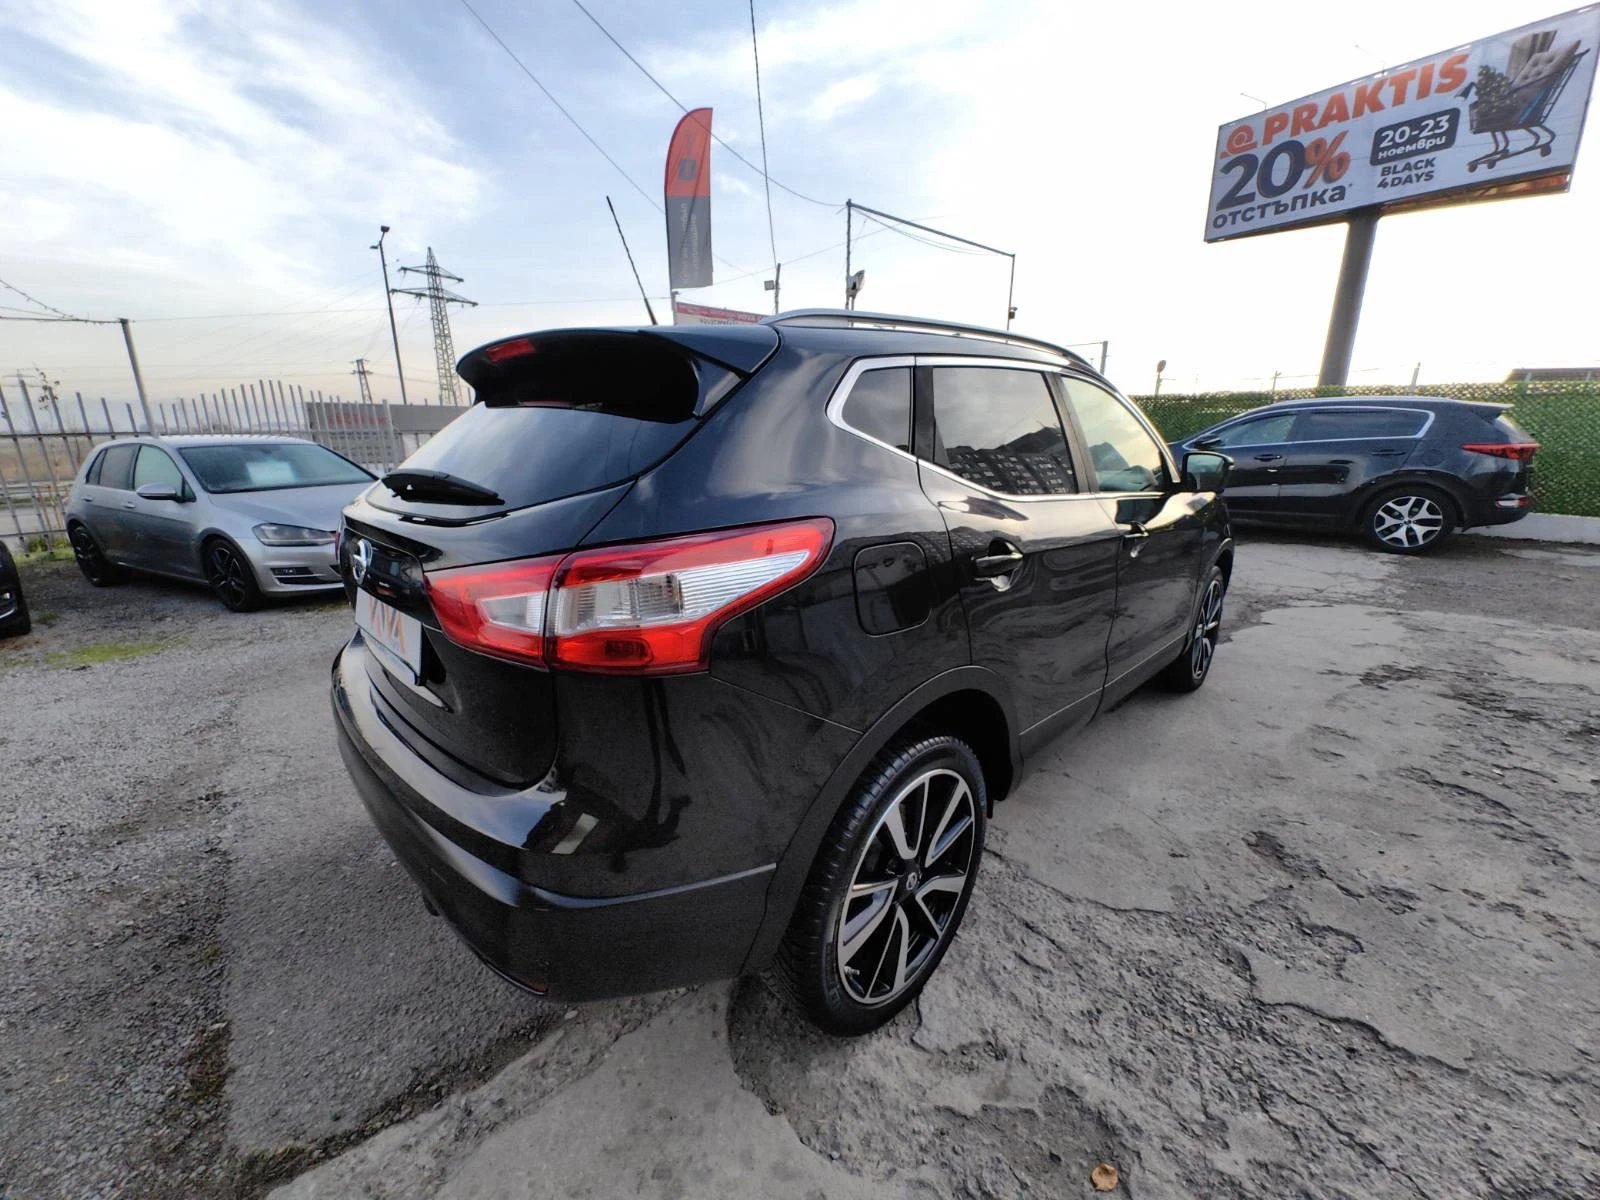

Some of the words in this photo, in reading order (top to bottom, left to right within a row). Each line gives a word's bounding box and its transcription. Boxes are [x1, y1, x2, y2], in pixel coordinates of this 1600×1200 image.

[1380, 114, 1450, 149] 20-23
[1377, 134, 1447, 160] ноември
[1215, 129, 1352, 212] 20%
[1381, 157, 1436, 177] BLACK
